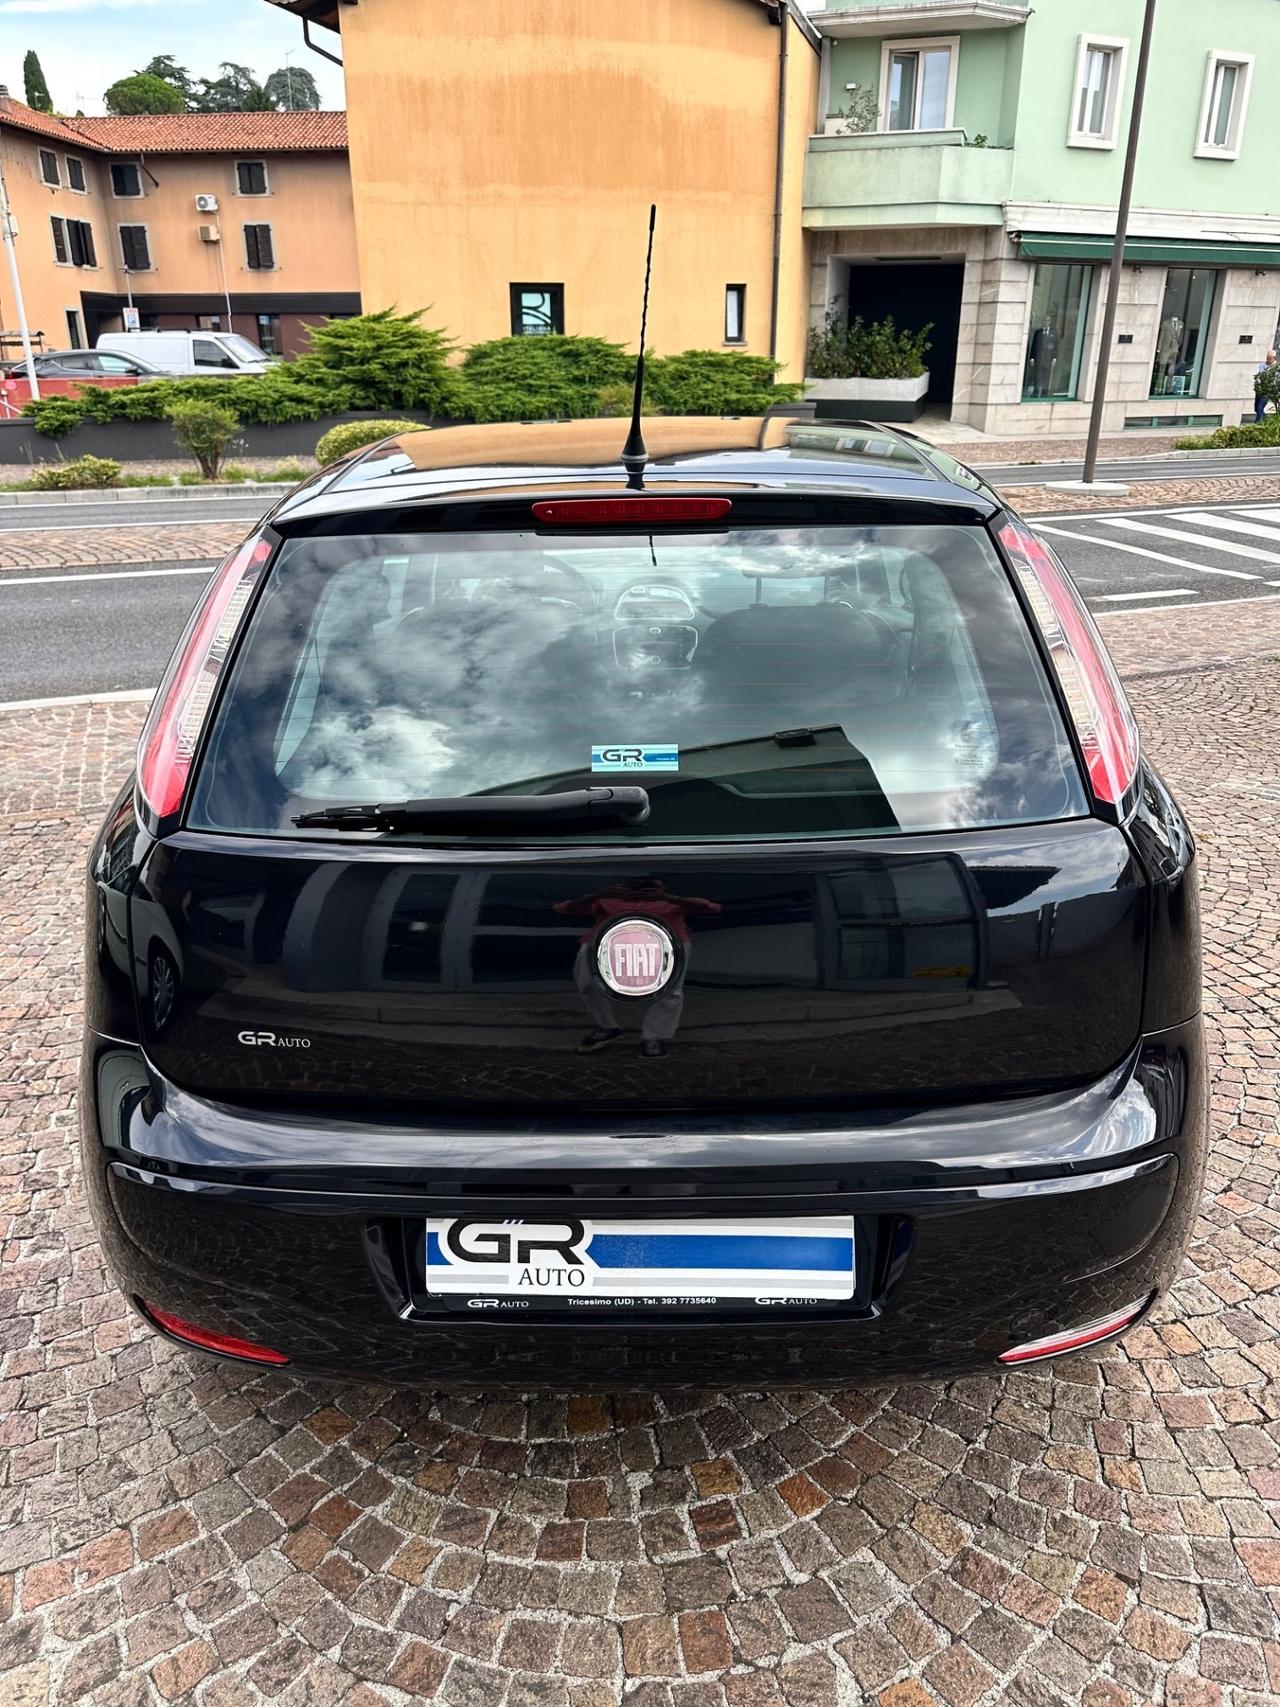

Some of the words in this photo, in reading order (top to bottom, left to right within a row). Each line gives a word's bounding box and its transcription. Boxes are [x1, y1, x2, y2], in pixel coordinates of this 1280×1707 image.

[603, 749, 642, 762] GR
[615, 943, 658, 977] FIAT
[238, 1031, 276, 1046] GR
[277, 1038, 311, 1048] AUTO
[447, 1218, 585, 1265] GR
[518, 1268, 585, 1287] AUTO
[467, 1299, 500, 1309] GR
[567, 1298, 612, 1306] Tricesimo
[614, 1298, 635, 1307] (UD)
[643, 1297, 659, 1305] Tel.
[661, 1297, 678, 1305] 392
[679, 1297, 717, 1305] 7735640
[755, 1297, 788, 1305] GR
